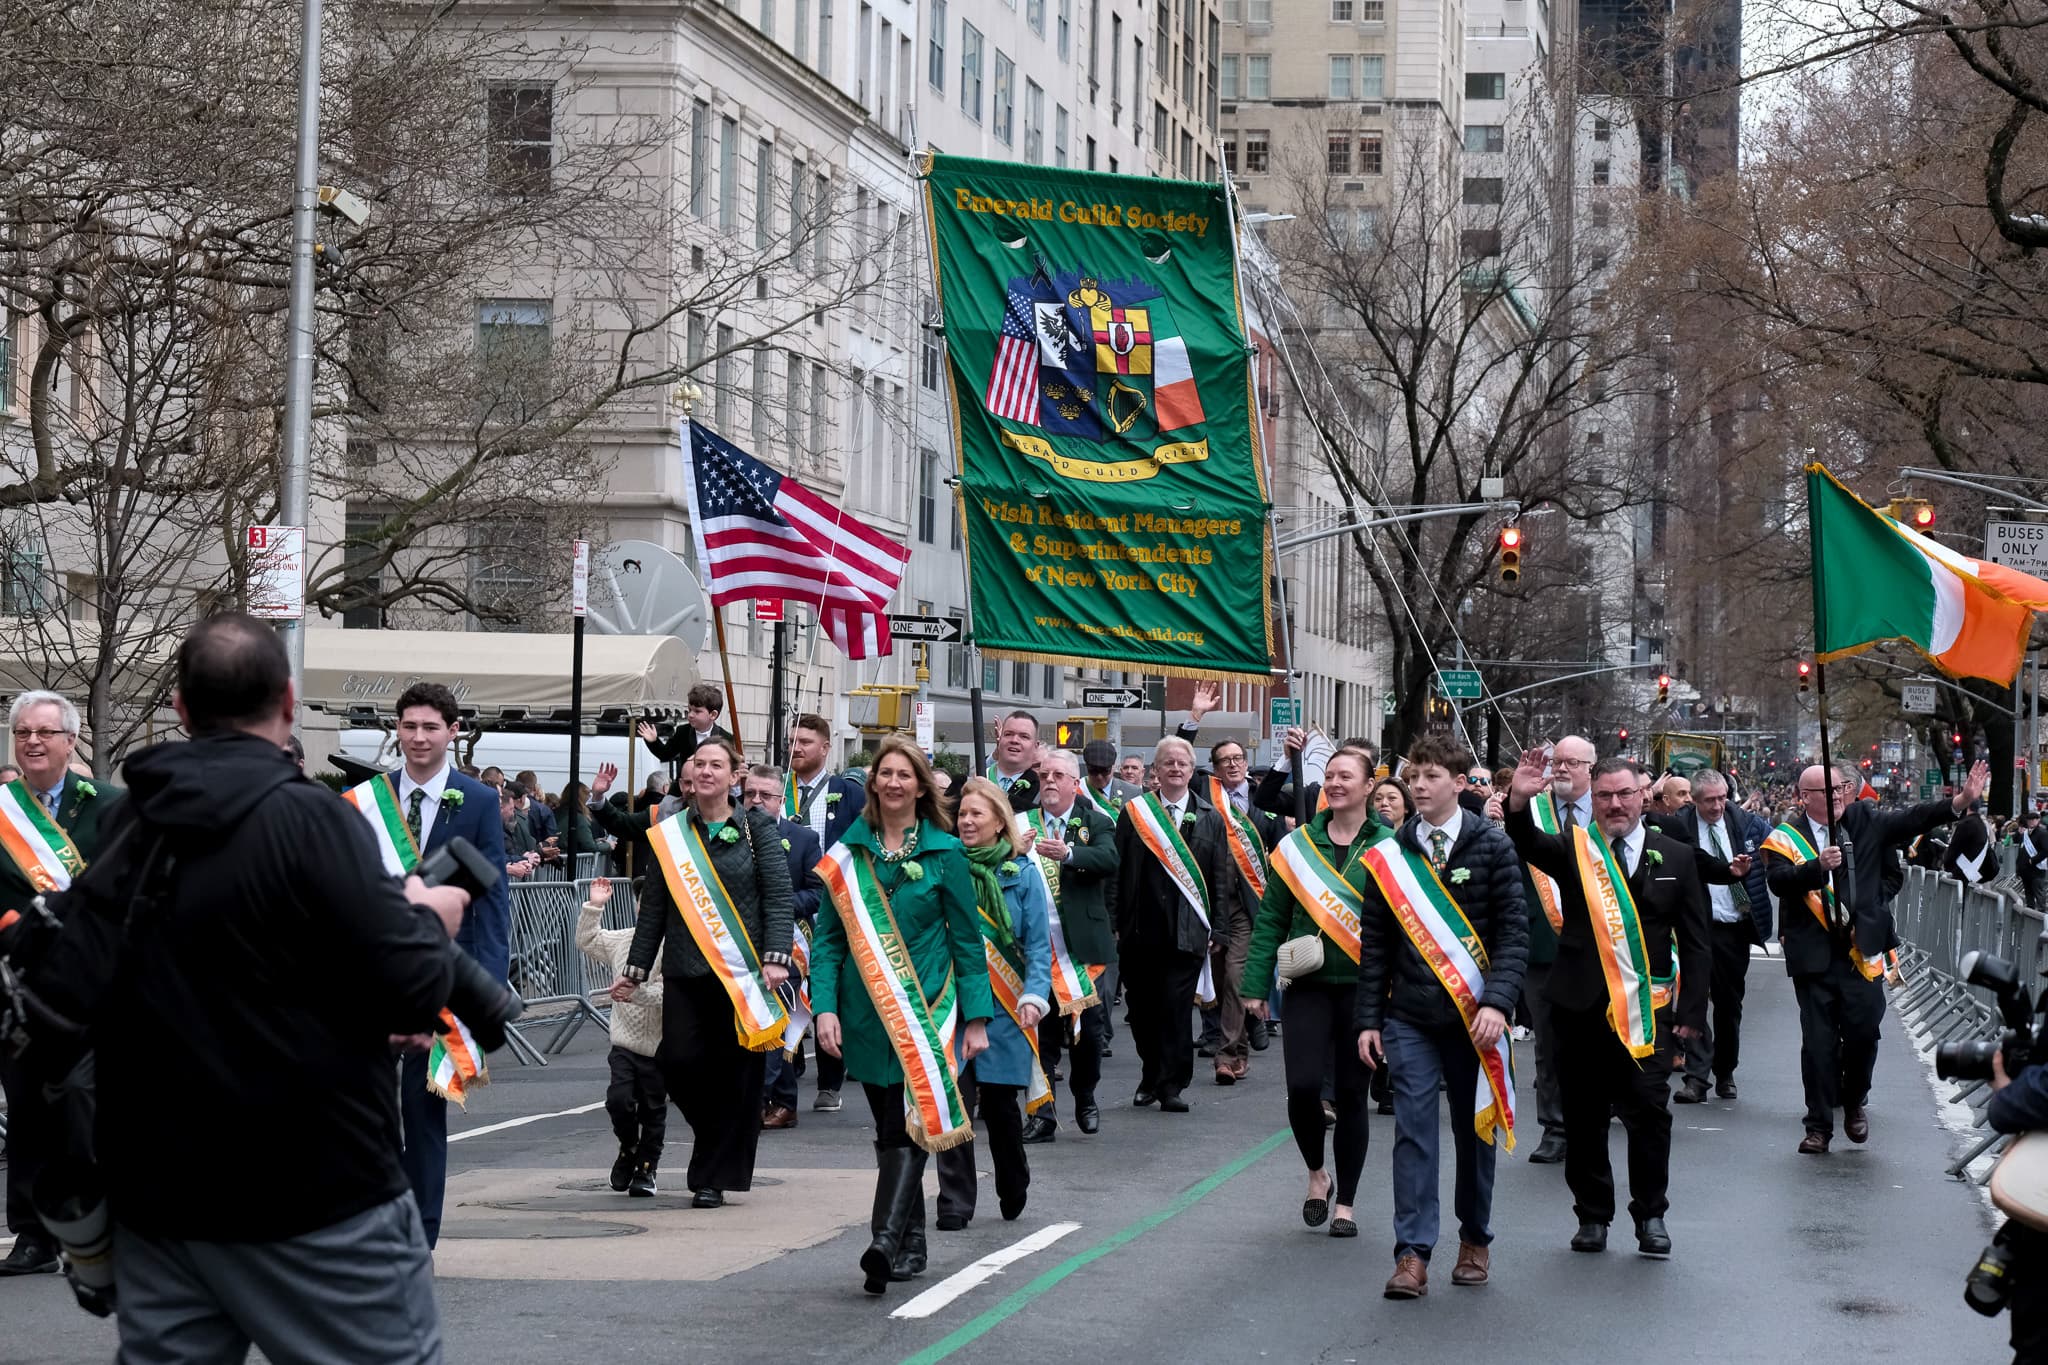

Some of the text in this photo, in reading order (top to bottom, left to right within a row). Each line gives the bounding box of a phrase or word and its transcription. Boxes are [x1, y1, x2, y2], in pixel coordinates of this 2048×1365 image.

[954, 188, 1210, 238] Emerald Guild Society
[1014, 439, 1070, 469] MERALD
[1083, 467, 1138, 477] GUILD
[983, 497, 1242, 538] Irish Resident Managers
[253, 529, 263, 547] 3
[1998, 526, 2044, 540] BUSES
[1009, 532, 1213, 565] & Superintendents
[2002, 542, 2039, 555] ONLY
[283, 562, 299, 571] ONLY
[2008, 557, 2048, 567] 7AM-7PM
[1025, 565, 1199, 598] of New York City
[892, 622, 947, 634] ONE WAY
[1034, 615, 1205, 646] www.emeraldguild.org
[341, 674, 396, 700] Eight
[1908, 687, 1930, 695] BUSES
[1910, 694, 1928, 702] ONLY
[1088, 694, 1133, 703] ONE WAY
[1272, 700, 1300, 709] Congeon
[680, 860, 728, 944] MARSHAL
[1593, 859, 1626, 946] MARSHAL
[879, 932, 912, 980] AIDE
